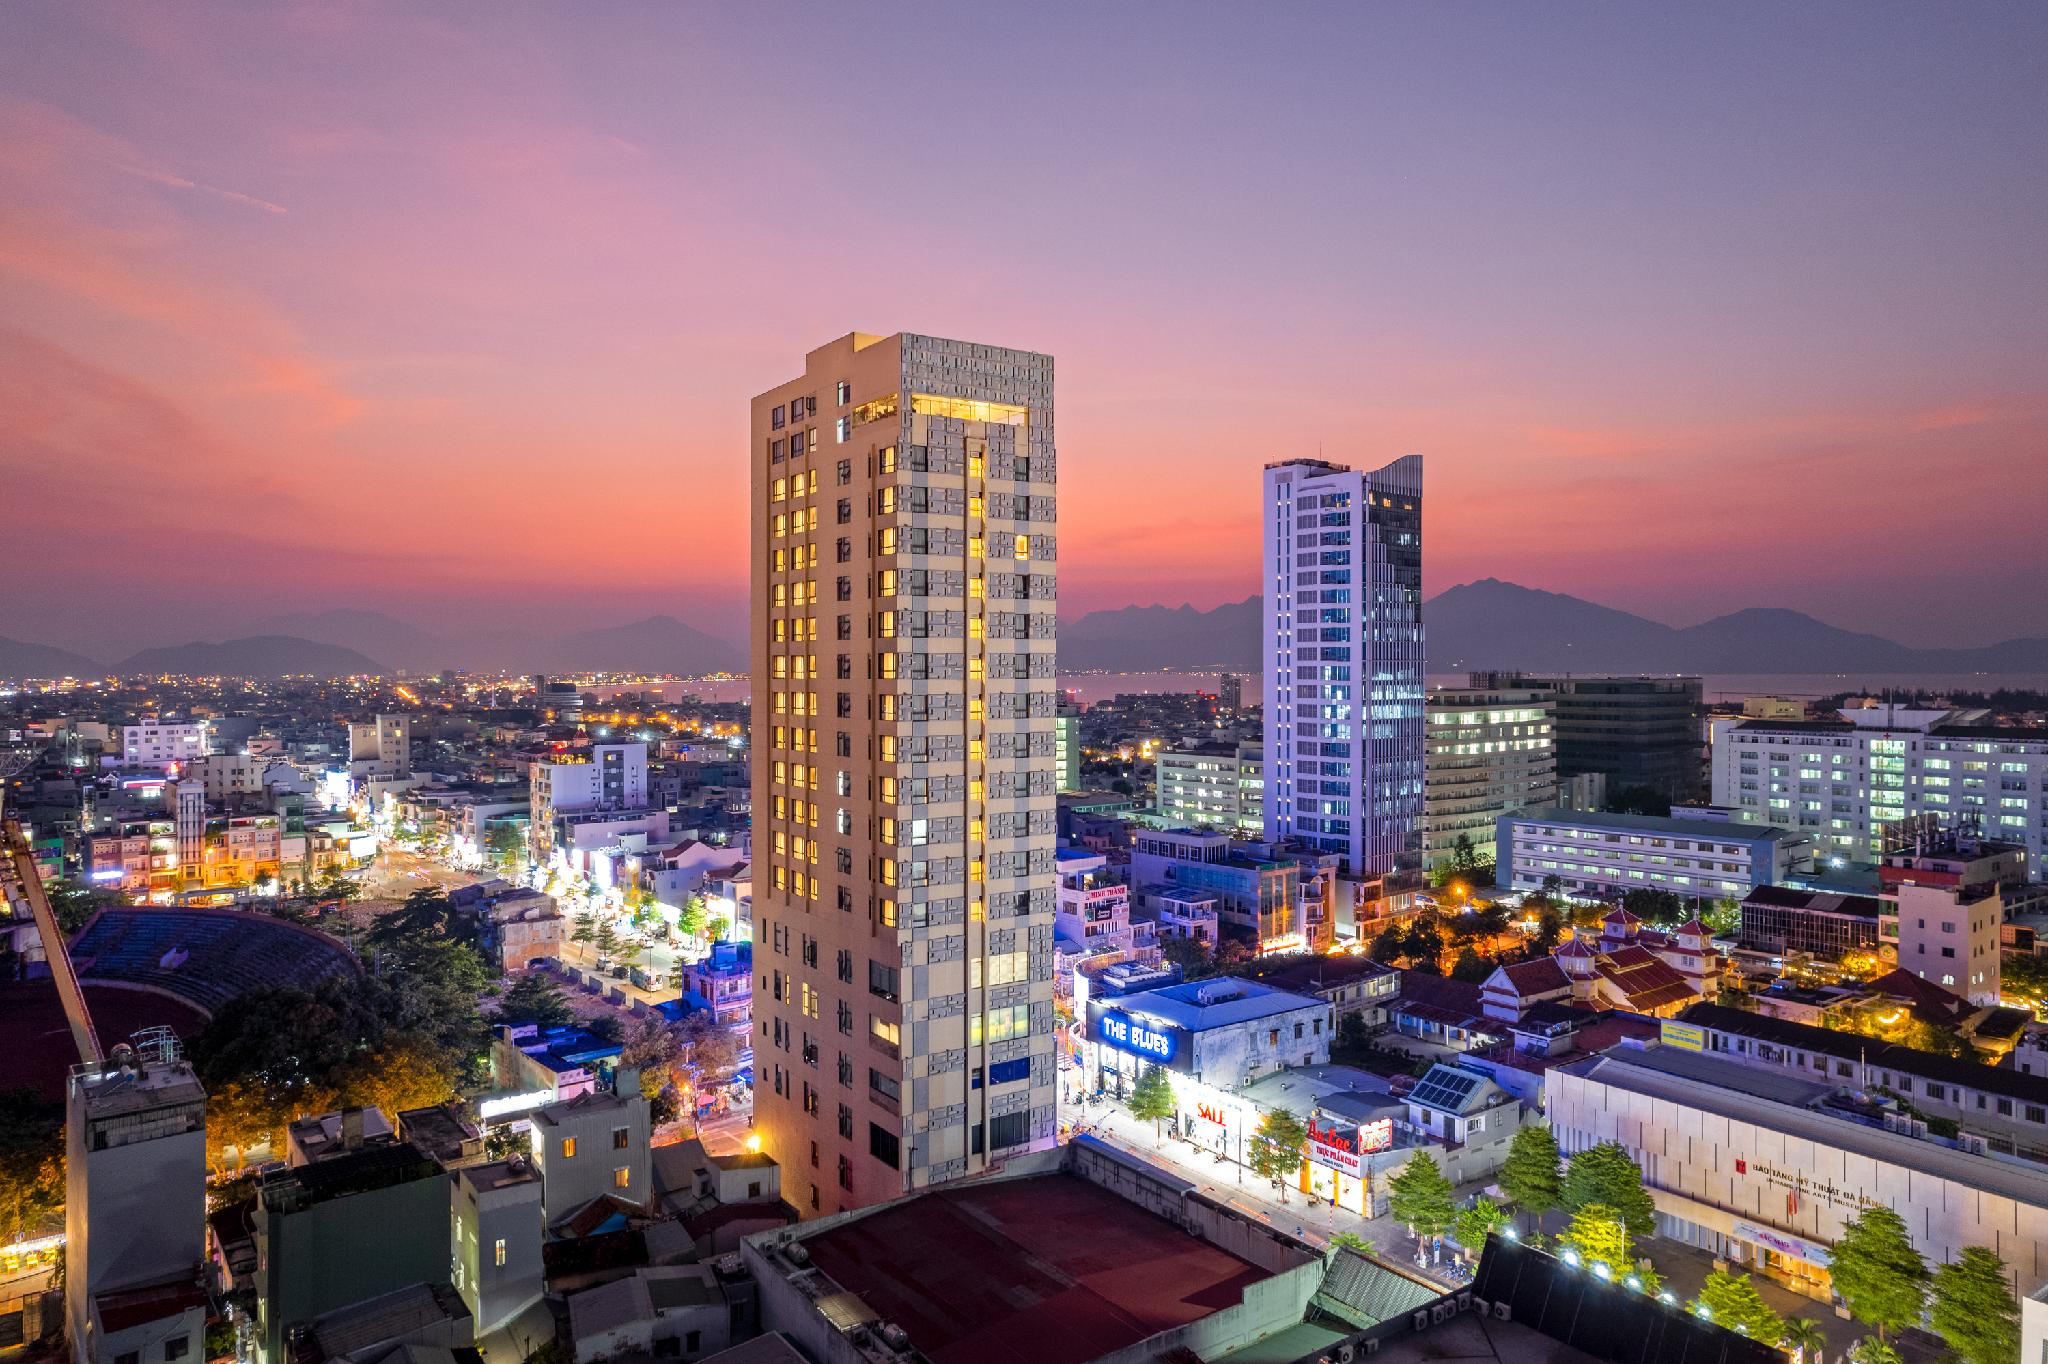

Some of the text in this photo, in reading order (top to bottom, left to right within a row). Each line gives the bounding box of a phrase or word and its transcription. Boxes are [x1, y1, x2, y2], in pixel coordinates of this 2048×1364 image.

[1091, 890, 1106, 898] MINH
[1103, 1017, 1168, 1055] THE BLUES
[1197, 1102, 1227, 1127] SALE
[1834, 1198, 1862, 1211] MUSEU
